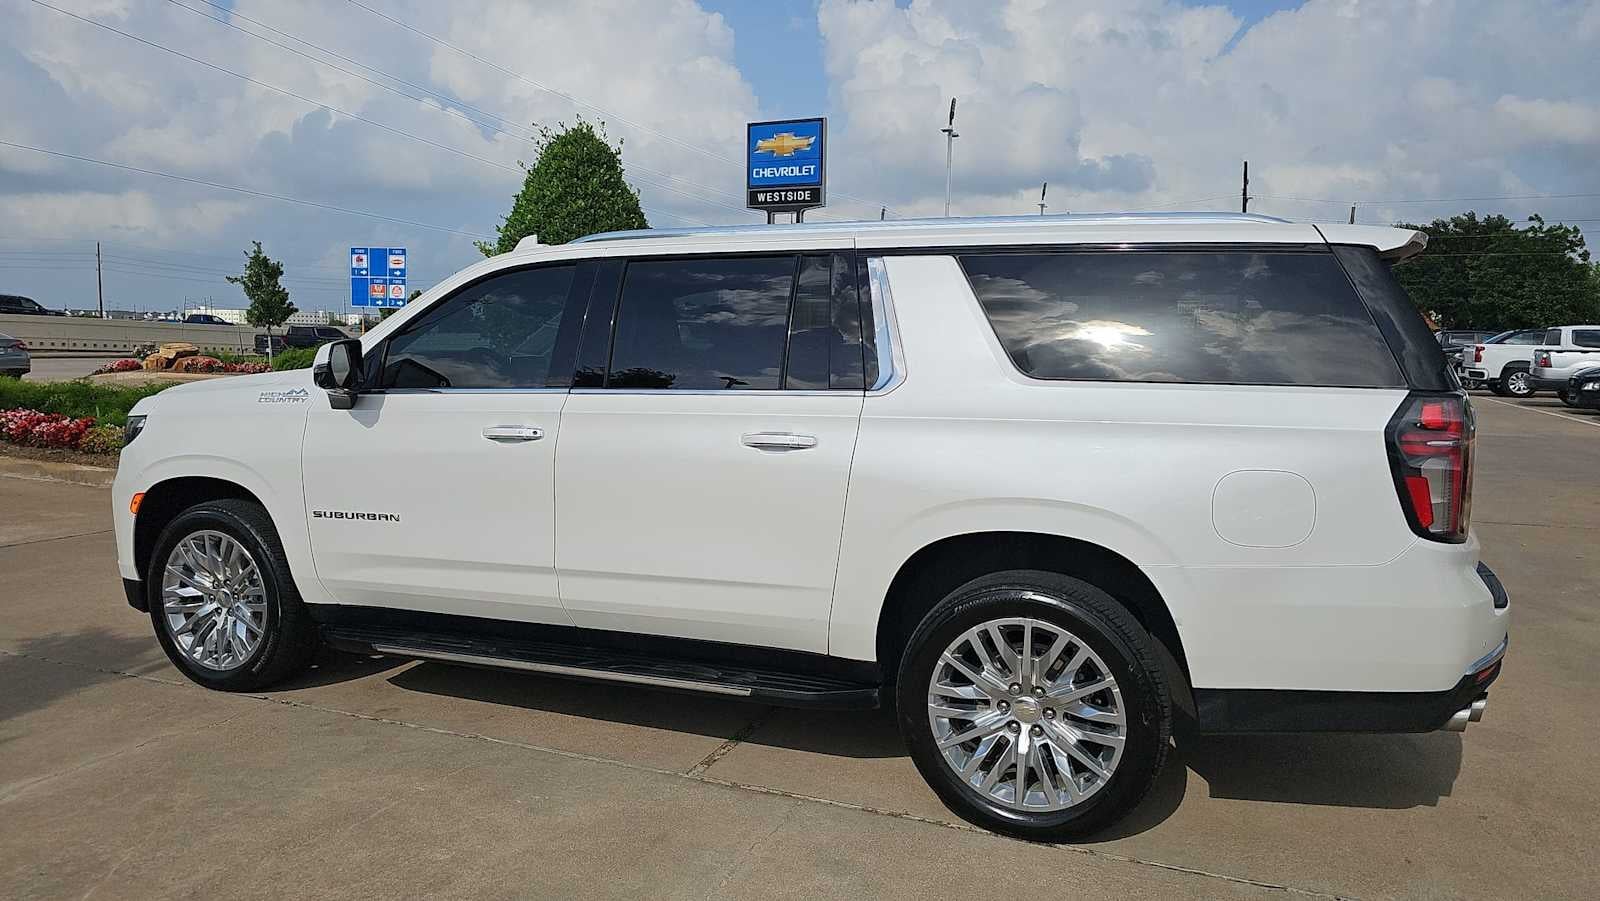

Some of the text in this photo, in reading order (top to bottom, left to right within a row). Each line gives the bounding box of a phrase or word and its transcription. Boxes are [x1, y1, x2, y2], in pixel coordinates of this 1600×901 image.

[753, 165, 816, 178] CHEVROLET
[757, 190, 811, 202] WESTSIDE
[312, 510, 401, 522] SUBURBAN
